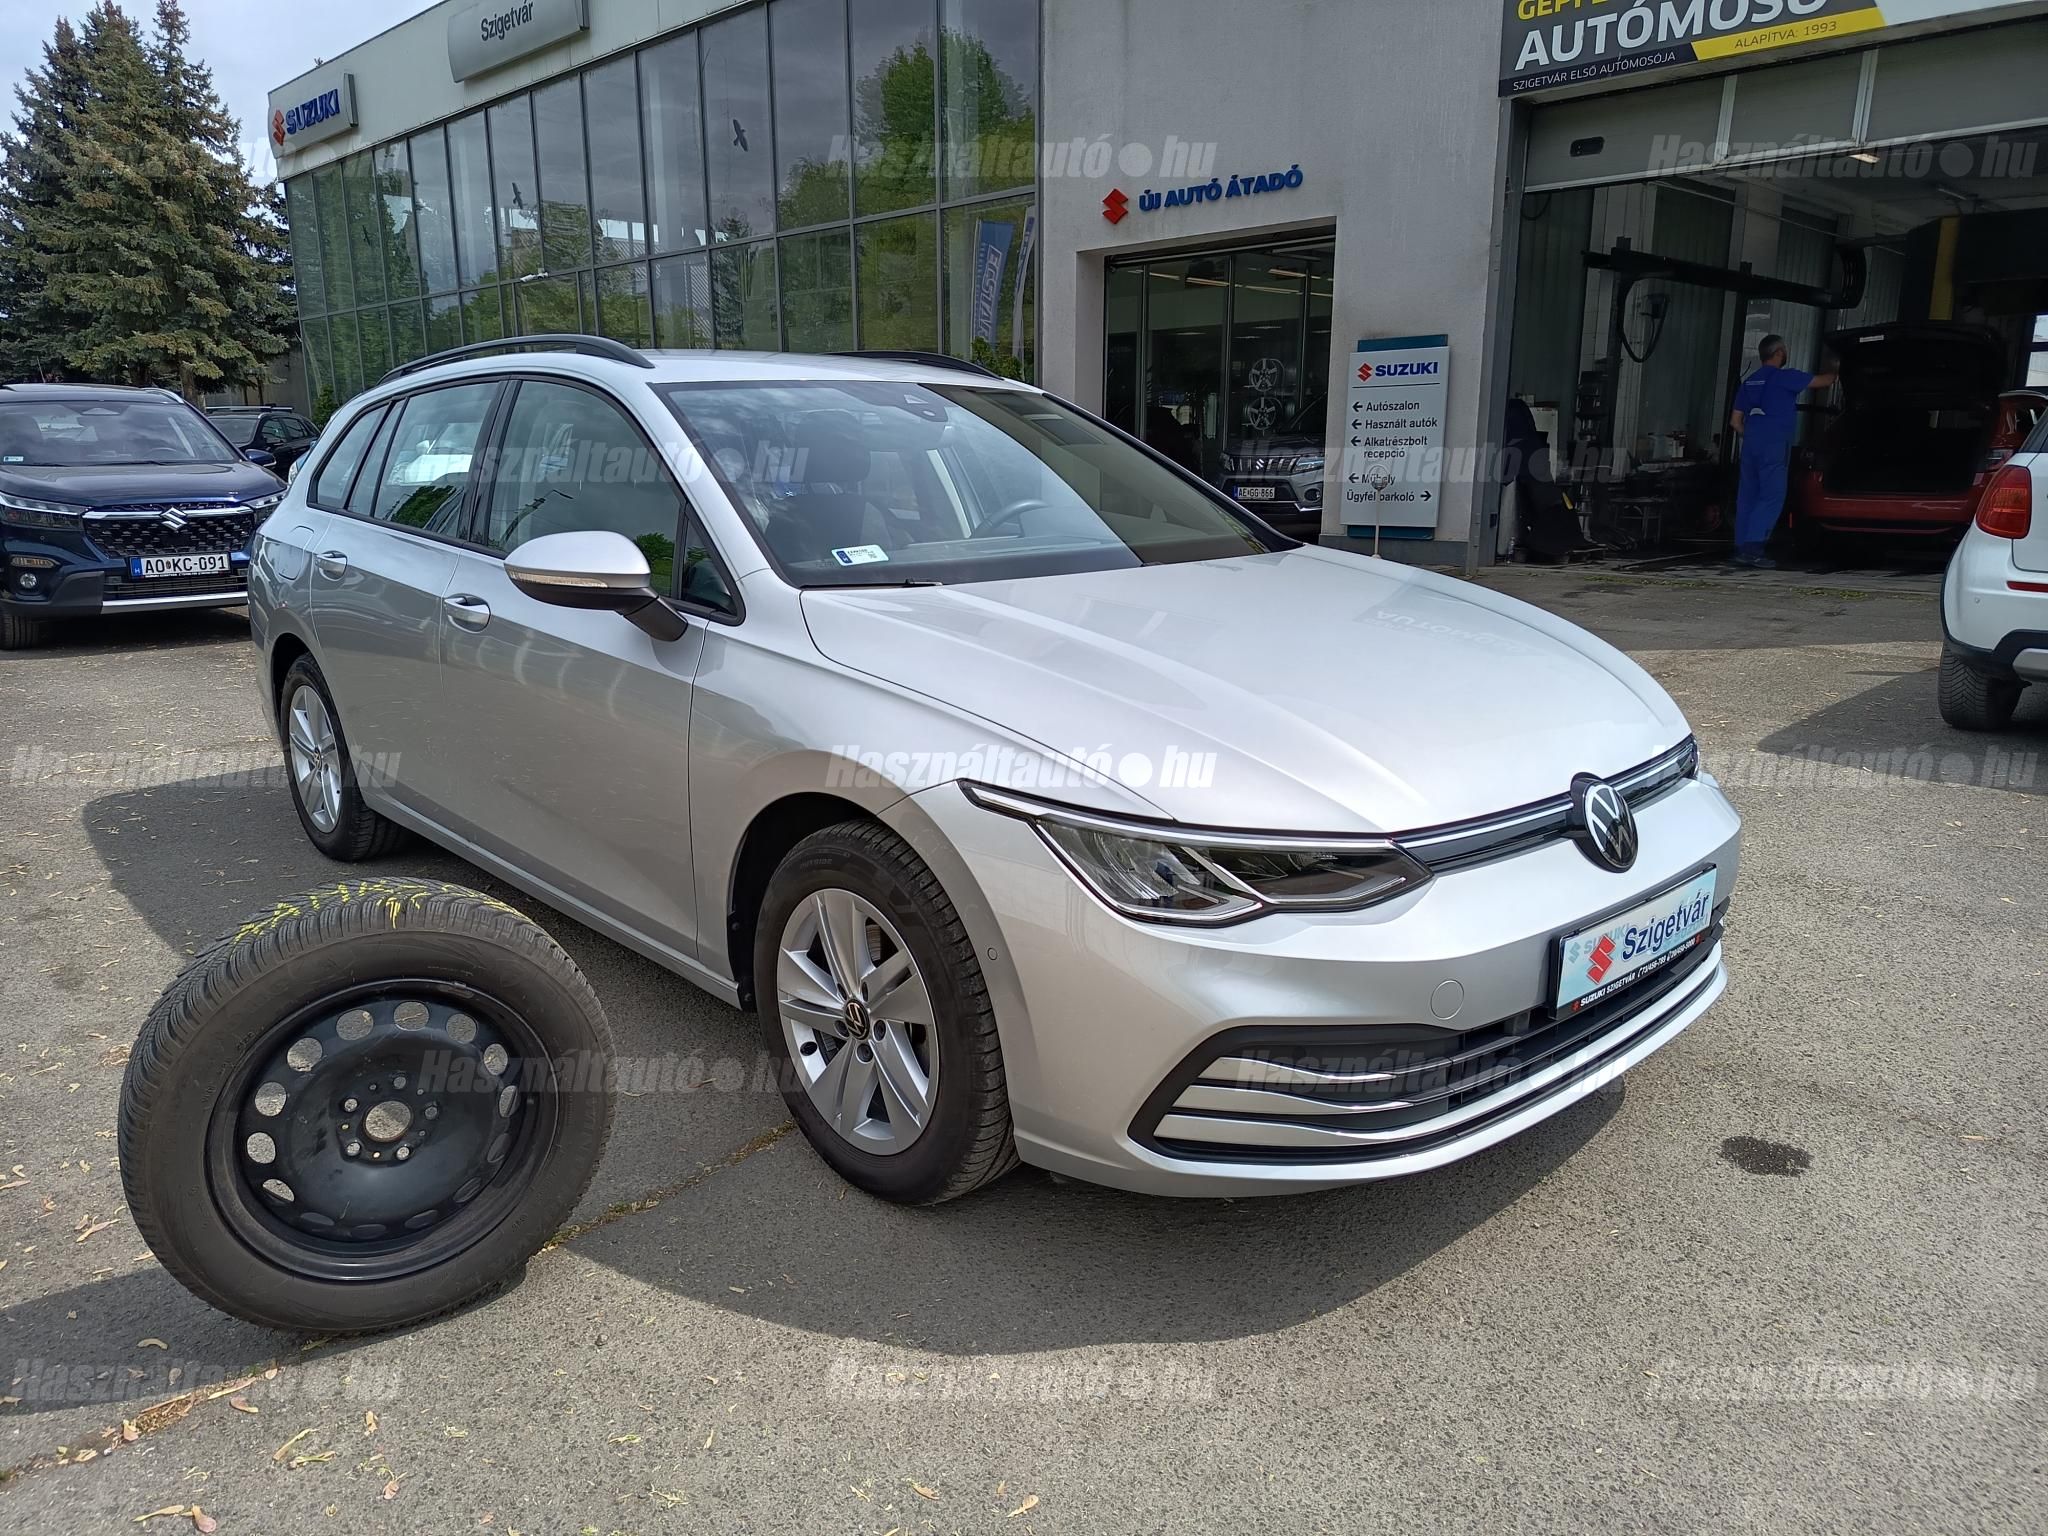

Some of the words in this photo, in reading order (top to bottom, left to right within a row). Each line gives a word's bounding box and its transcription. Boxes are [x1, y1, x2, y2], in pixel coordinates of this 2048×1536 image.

[481, 0, 533, 41] Szigetvár
[1804, 21, 1837, 36] 1993
[1513, 72, 1567, 91] SZIGETVÁR
[1570, 65, 1597, 80] ELSŐ
[1599, 51, 1676, 75] AUTÓMOSÓJA
[286, 88, 340, 135] SUZUKI
[1139, 189, 1161, 212] ÚJ
[1164, 177, 1223, 208] AUTÓ
[1225, 164, 1304, 198] ÁTADÓ
[1375, 362, 1438, 377] SUZUKI
[1366, 400, 1420, 412] Autószalon
[1365, 418, 1407, 430] Használt
[1409, 417, 1438, 428] autók
[1364, 436, 1428, 447] Alkatrészbolt
[1363, 447, 1406, 459] recepció
[1346, 489, 1377, 503] Ügyfél
[1622, 892, 1709, 960] Szigetvár
[1580, 986, 1606, 1007] SUZUKI
